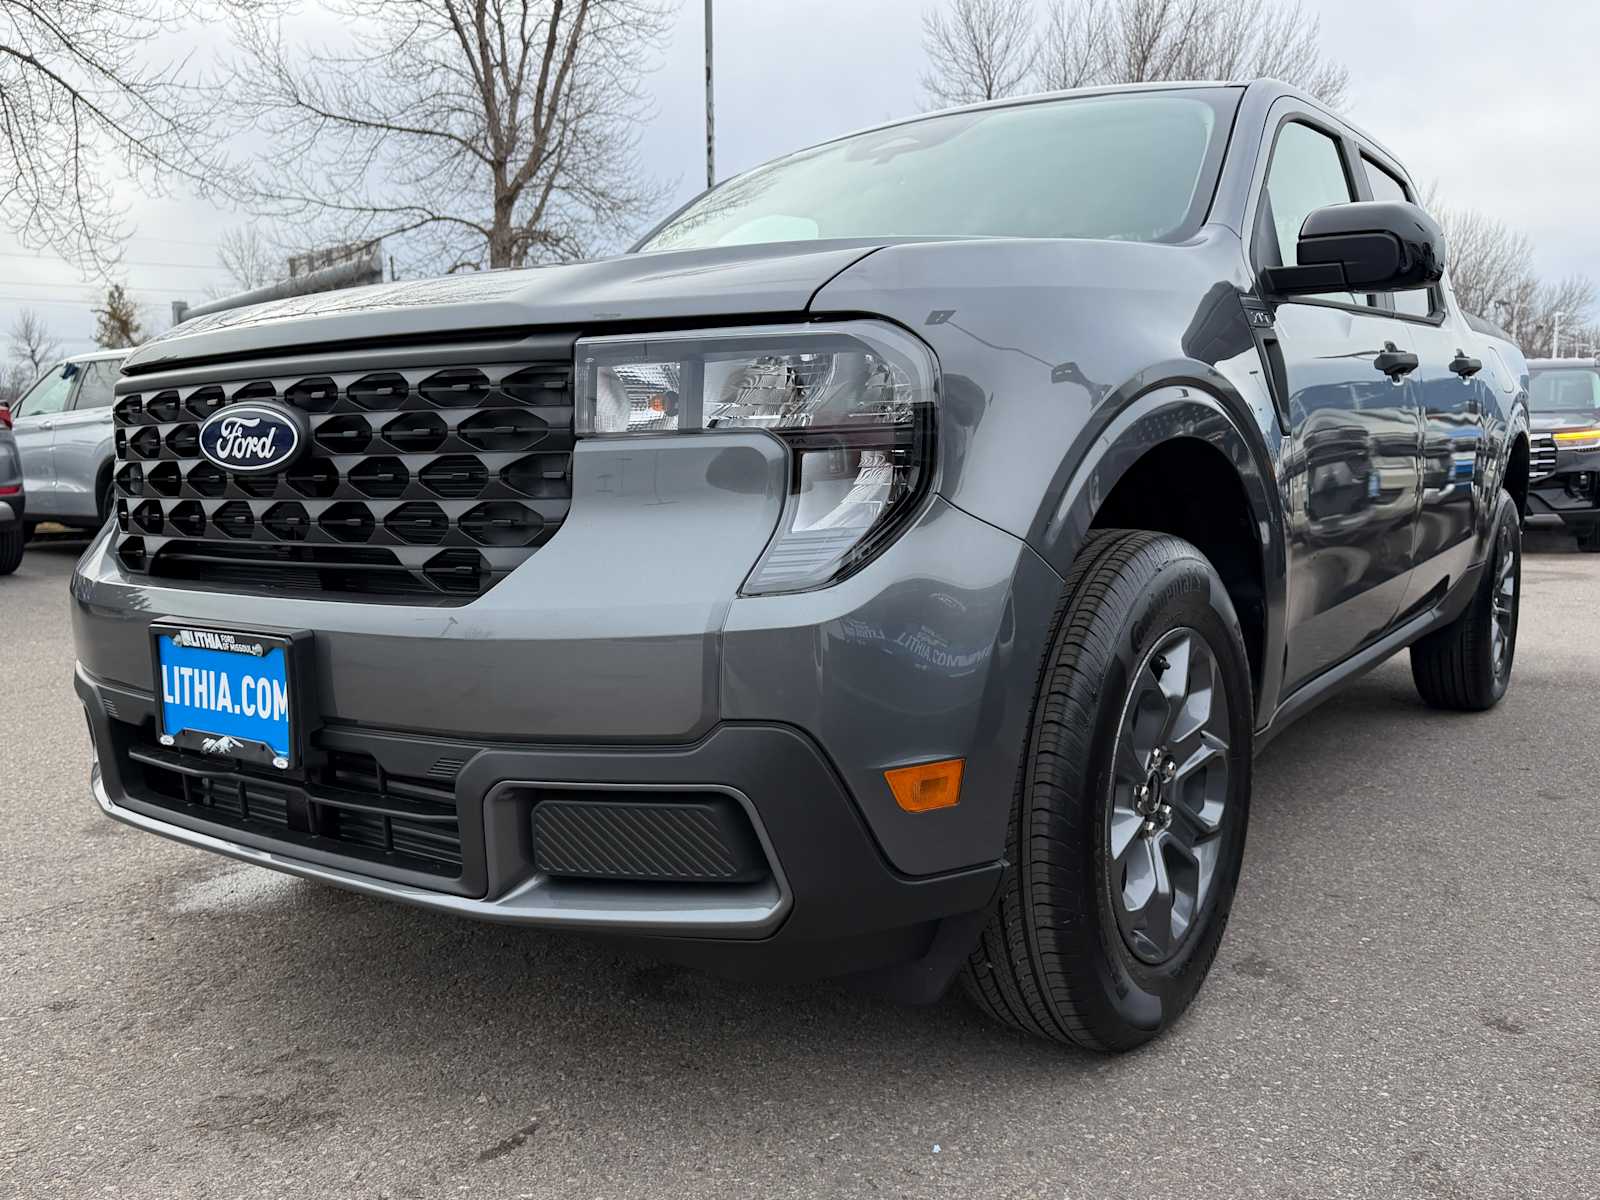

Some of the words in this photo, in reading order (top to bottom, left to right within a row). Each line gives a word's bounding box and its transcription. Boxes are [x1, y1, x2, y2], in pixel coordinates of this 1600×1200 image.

[216, 417, 276, 459] Ford
[190, 631, 223, 650] LITHIA
[162, 664, 288, 722] LITHIA.COM
